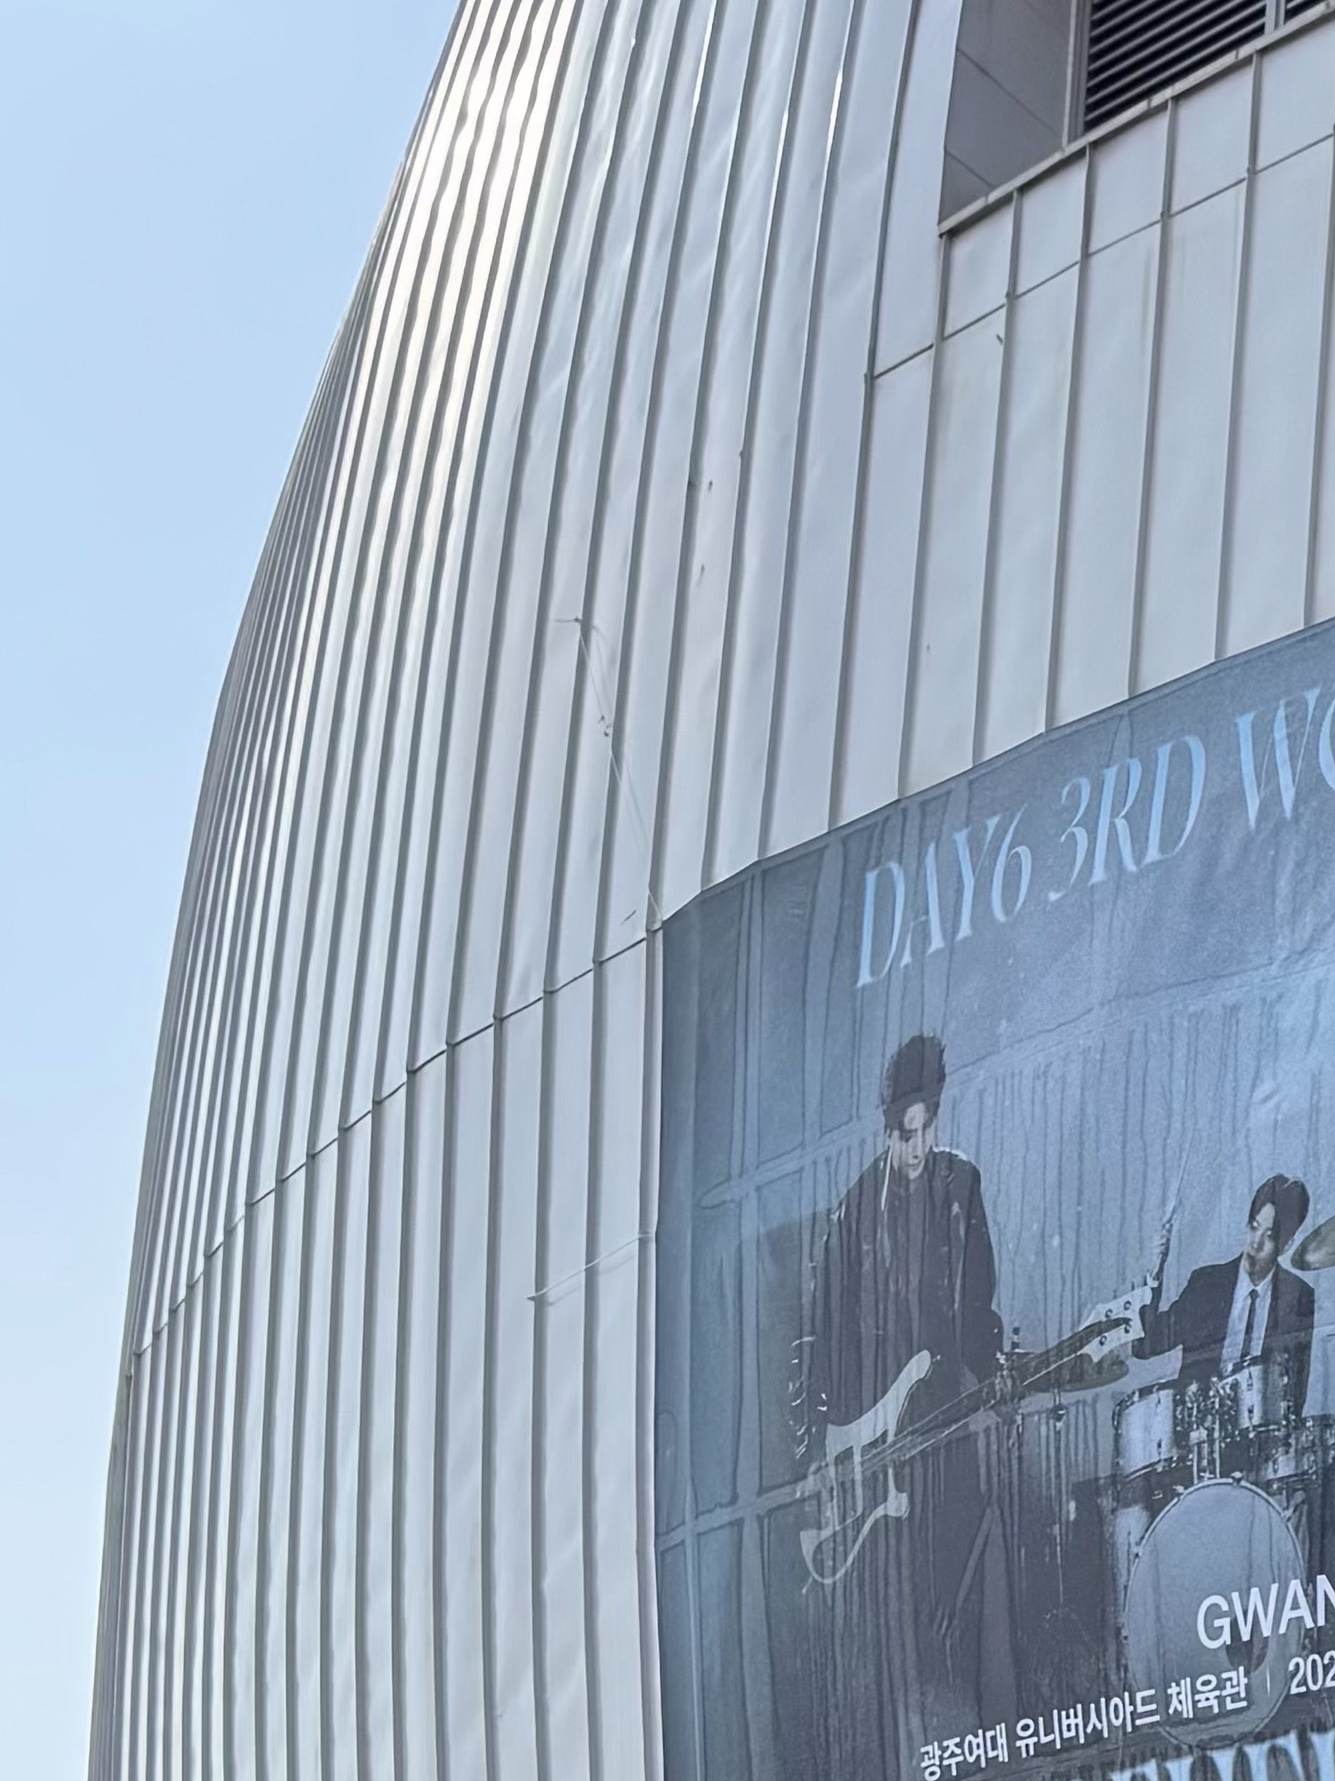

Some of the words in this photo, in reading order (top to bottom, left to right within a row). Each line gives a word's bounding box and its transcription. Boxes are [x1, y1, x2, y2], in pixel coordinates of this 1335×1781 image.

[856, 805, 1032, 988] DAY6
[1048, 735, 1206, 902] 3RD
[1015, 1687, 1160, 1759] 유니버시아드
[1166, 1665, 1248, 1720] 체육관
